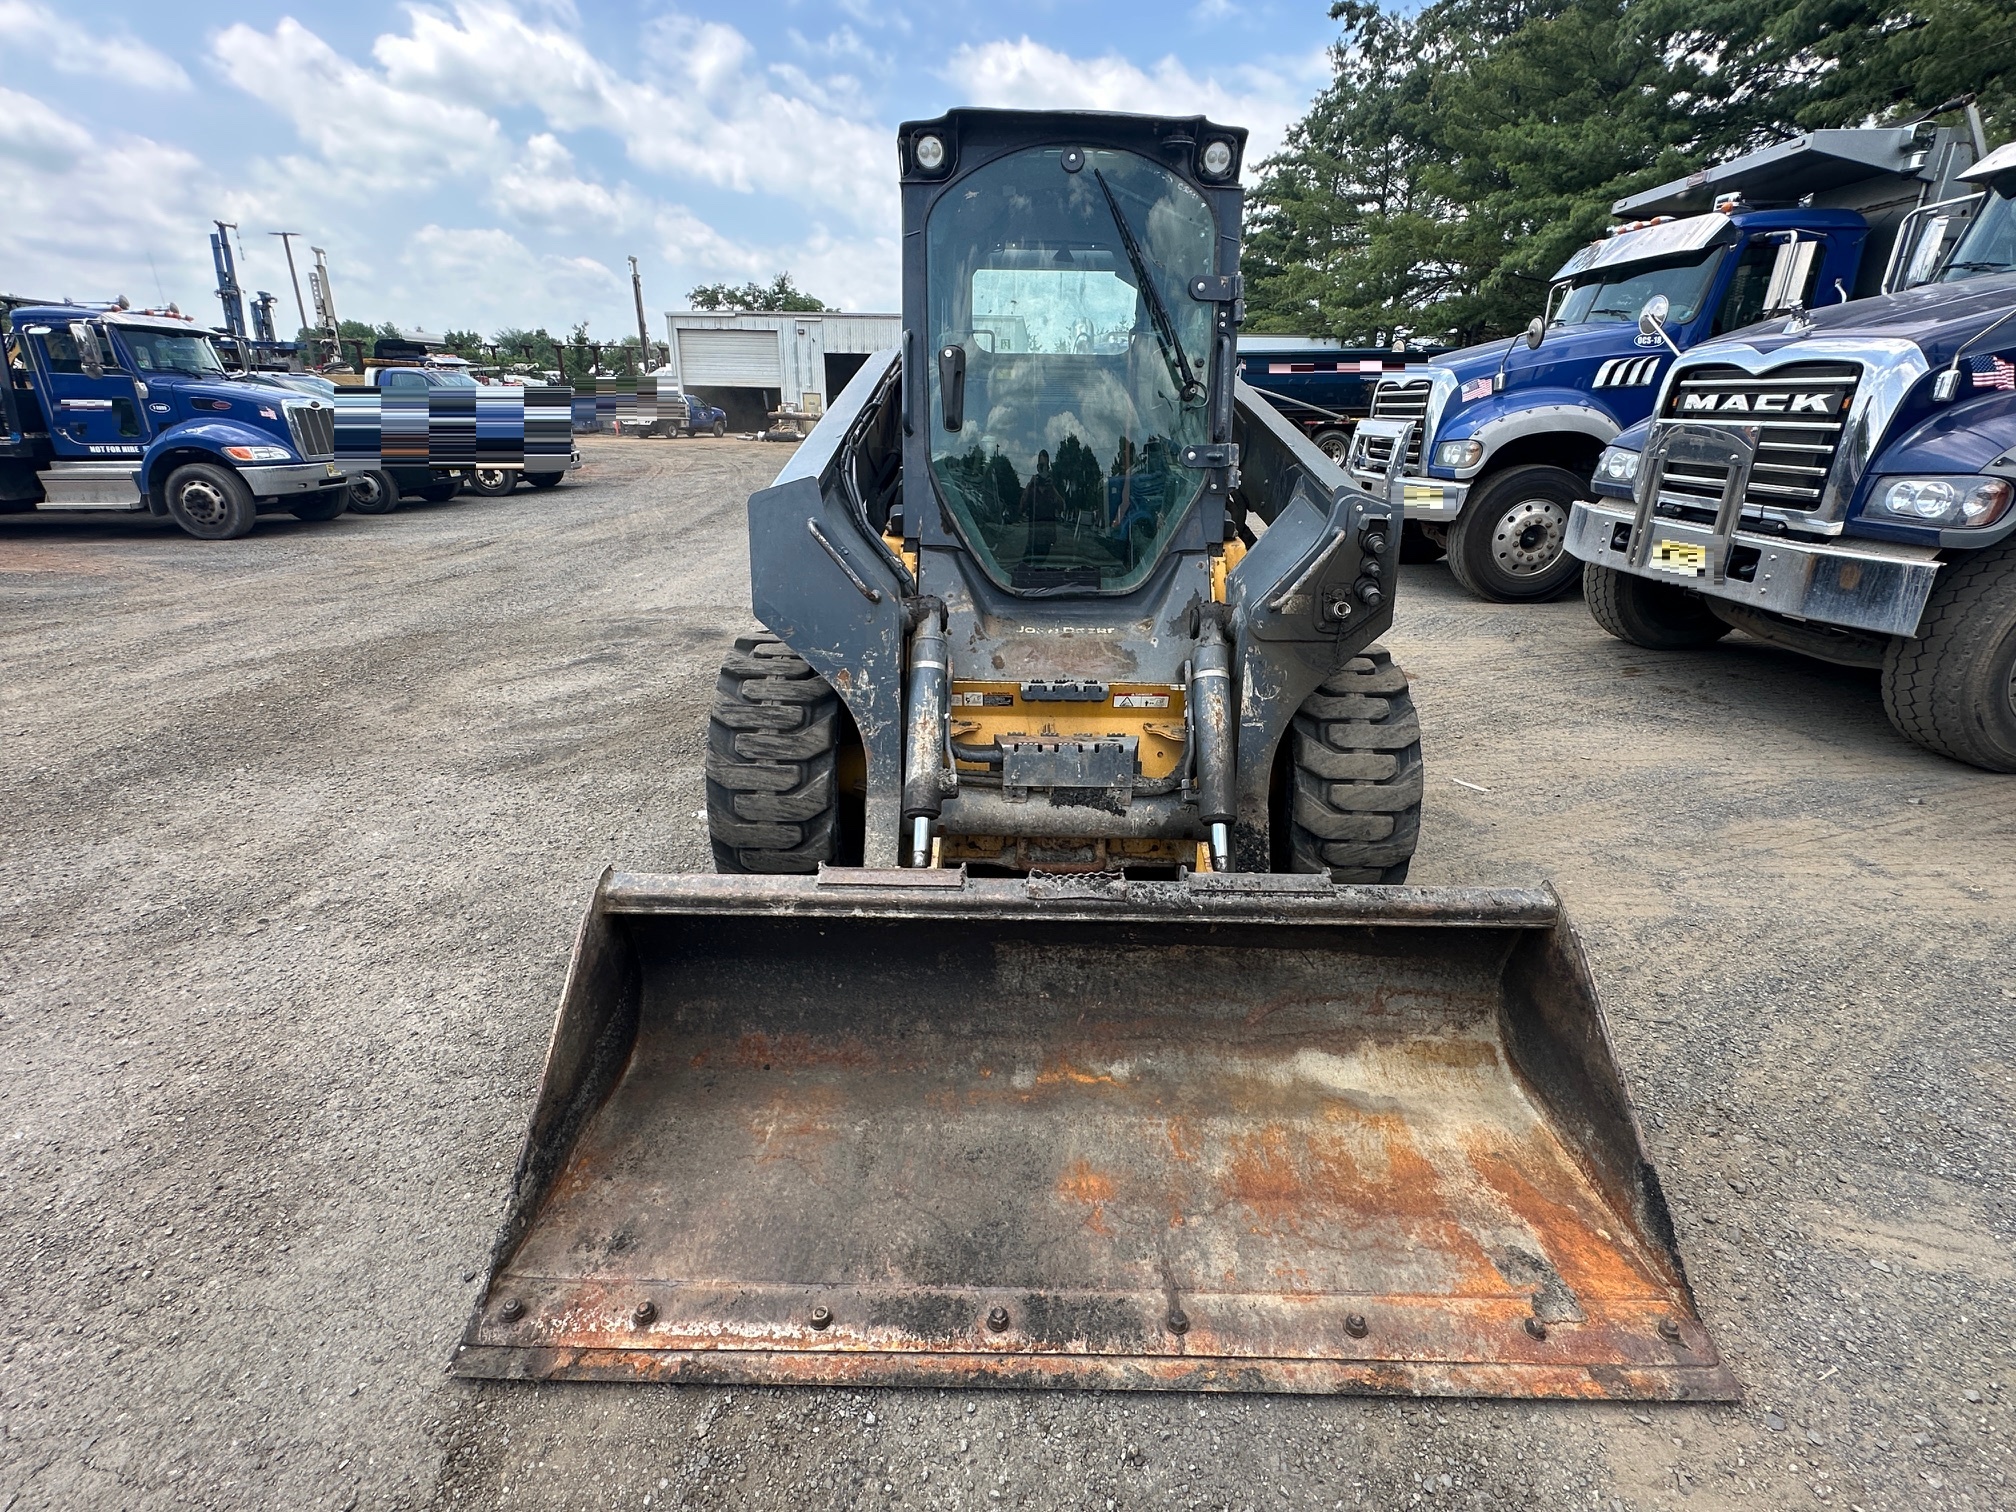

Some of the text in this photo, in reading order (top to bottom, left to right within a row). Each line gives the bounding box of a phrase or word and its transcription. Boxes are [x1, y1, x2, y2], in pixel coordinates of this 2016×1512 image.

[1683, 393, 1834, 413] MACK
[89, 445, 105, 453] NOT
[105, 445, 121, 453] FOR
[121, 445, 141, 453] HIRE
